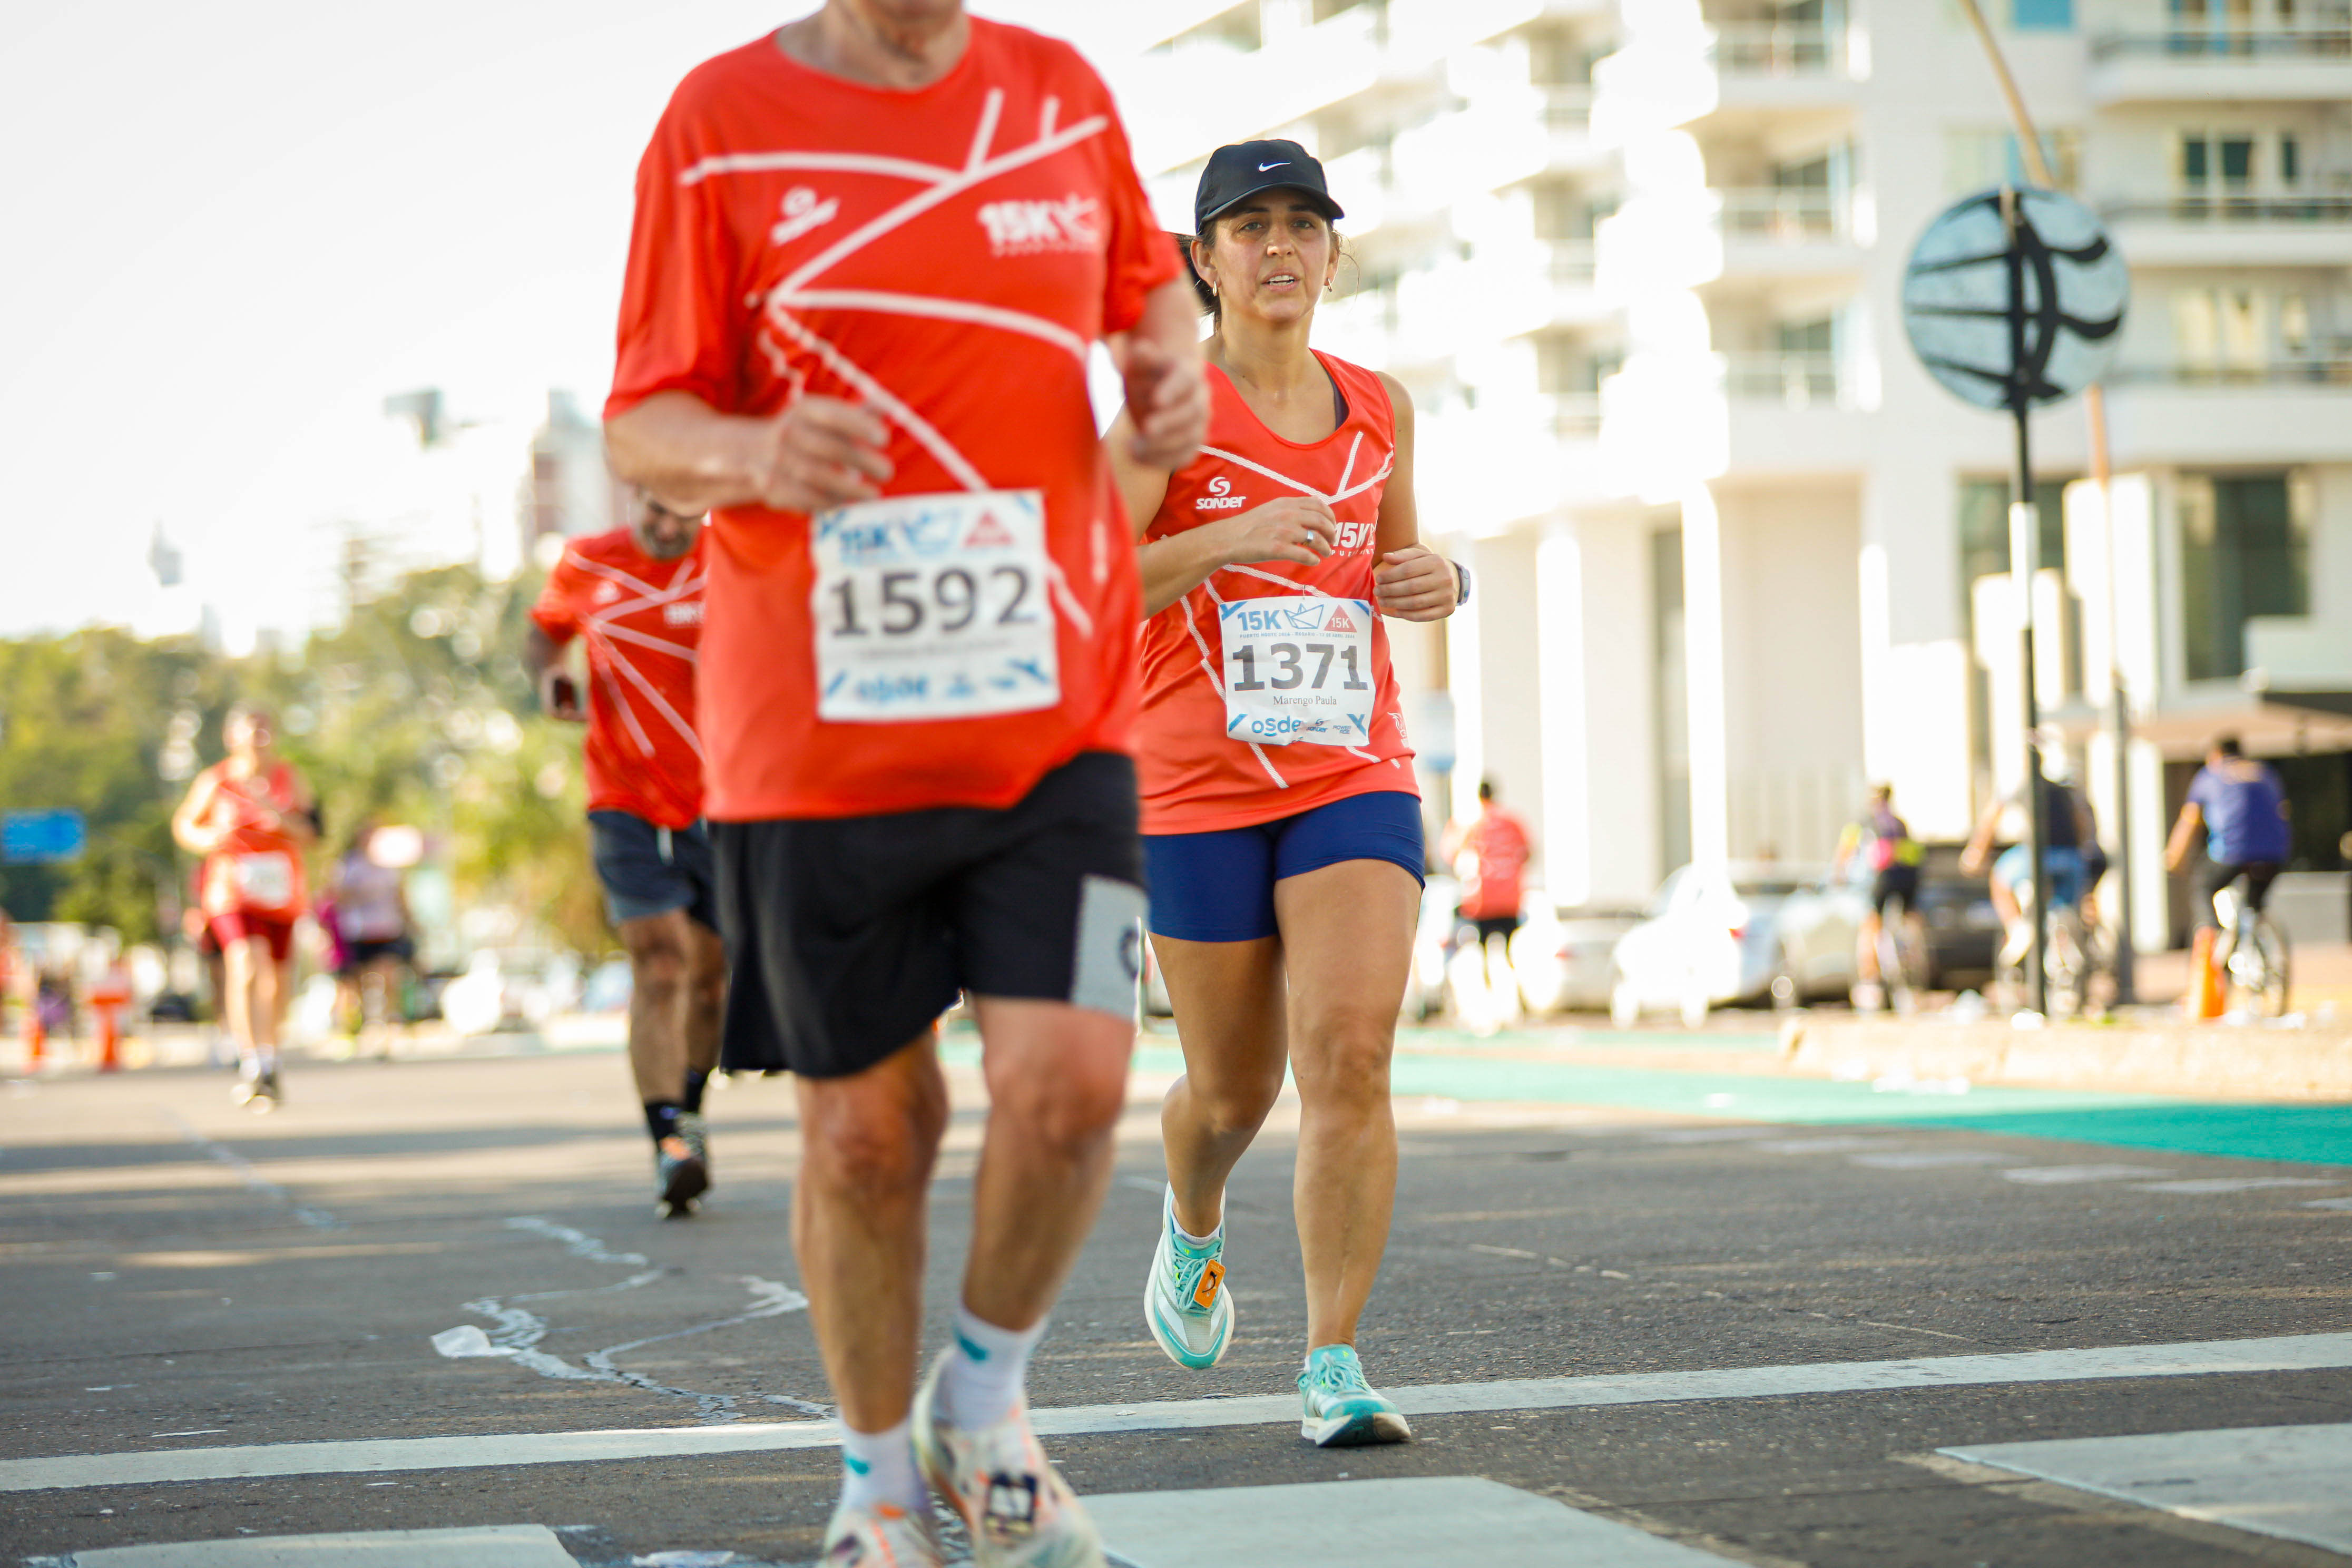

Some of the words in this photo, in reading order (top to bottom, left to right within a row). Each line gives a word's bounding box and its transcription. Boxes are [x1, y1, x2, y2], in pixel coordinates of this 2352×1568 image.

[830, 565, 1037, 638] 1592
[1237, 610, 1282, 631] 15K
[1331, 617, 1350, 629] 15K
[1232, 642, 1368, 691] 1371
[1273, 695, 1313, 707] Marengo
[1315, 695, 1337, 705] Paula
[1251, 715, 1302, 734] osde
